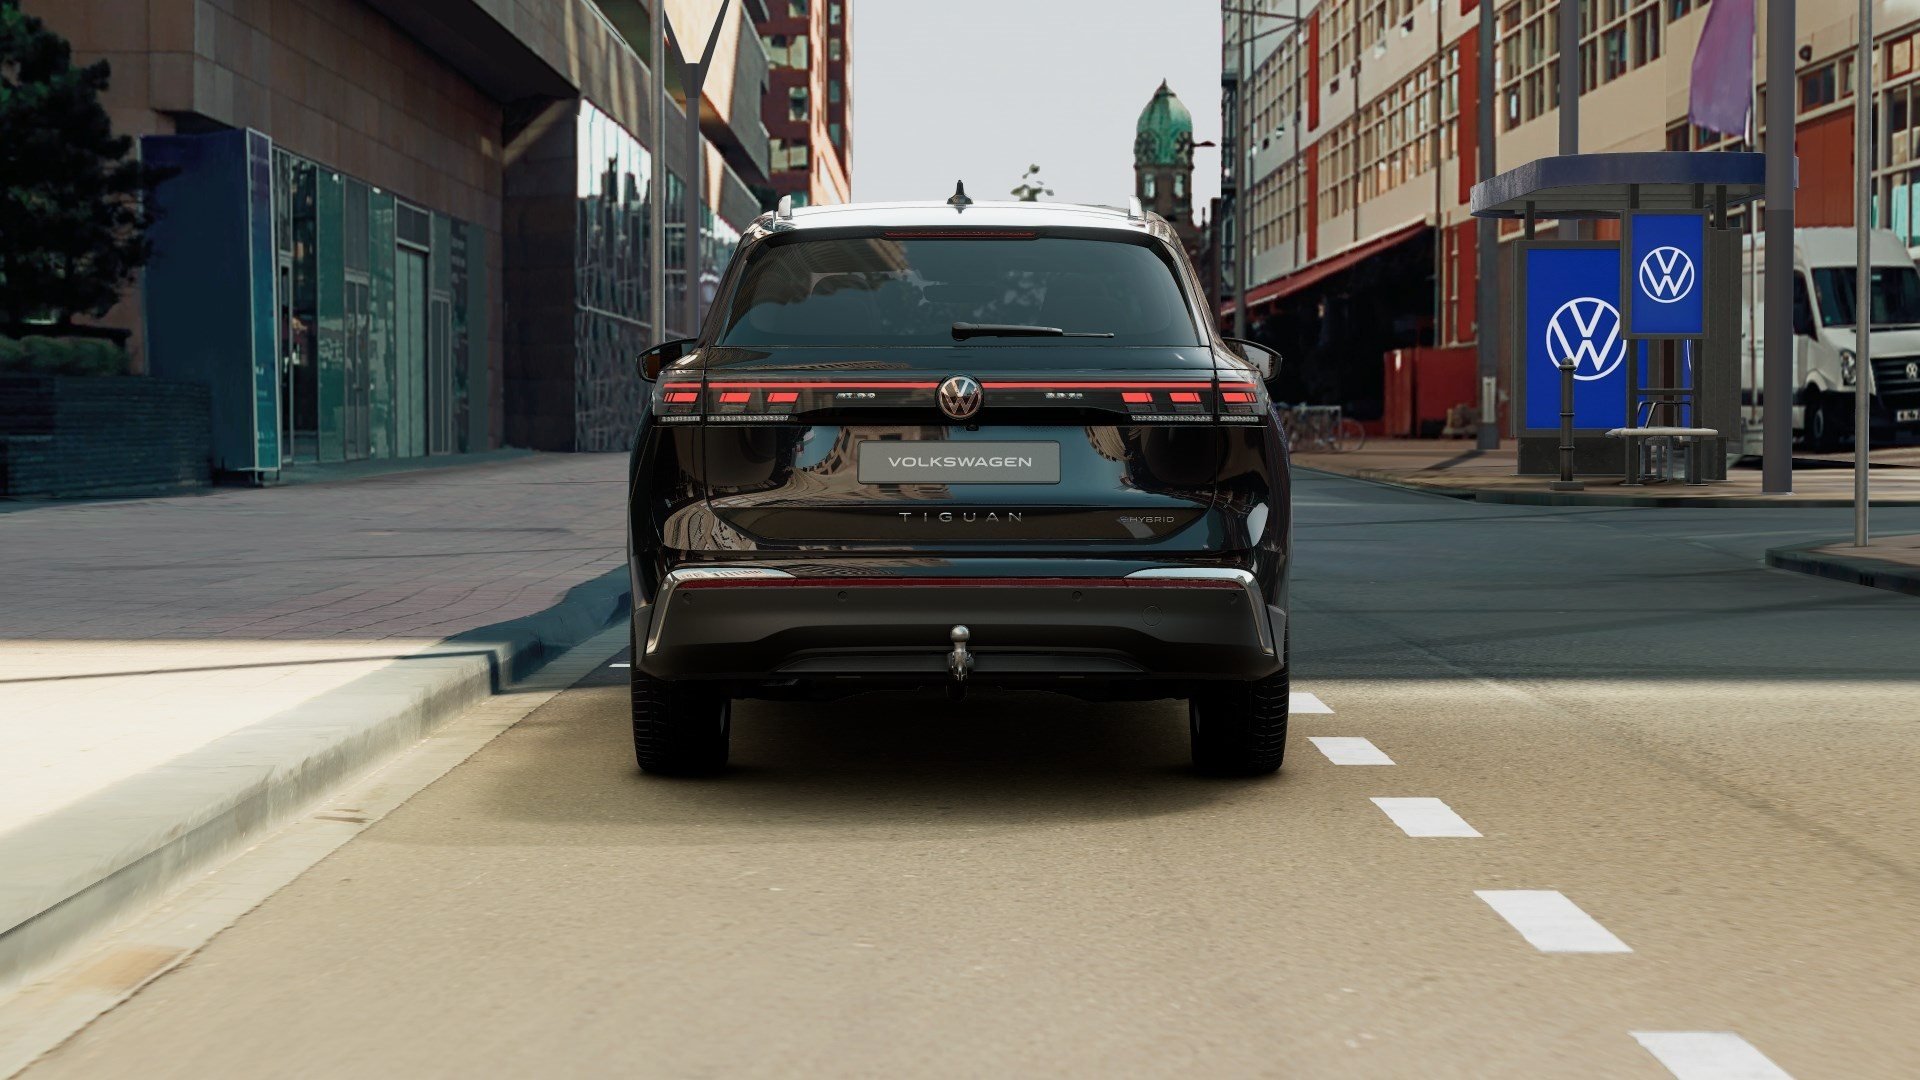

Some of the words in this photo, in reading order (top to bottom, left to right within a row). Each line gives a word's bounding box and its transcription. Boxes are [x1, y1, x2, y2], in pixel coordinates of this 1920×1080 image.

[1640, 247, 1694, 300] VW
[1548, 299, 1623, 376] VW
[940, 377, 980, 417] VW
[888, 457, 1032, 467] VOLKSWAGEN
[898, 512, 1023, 522] TIGUAN
